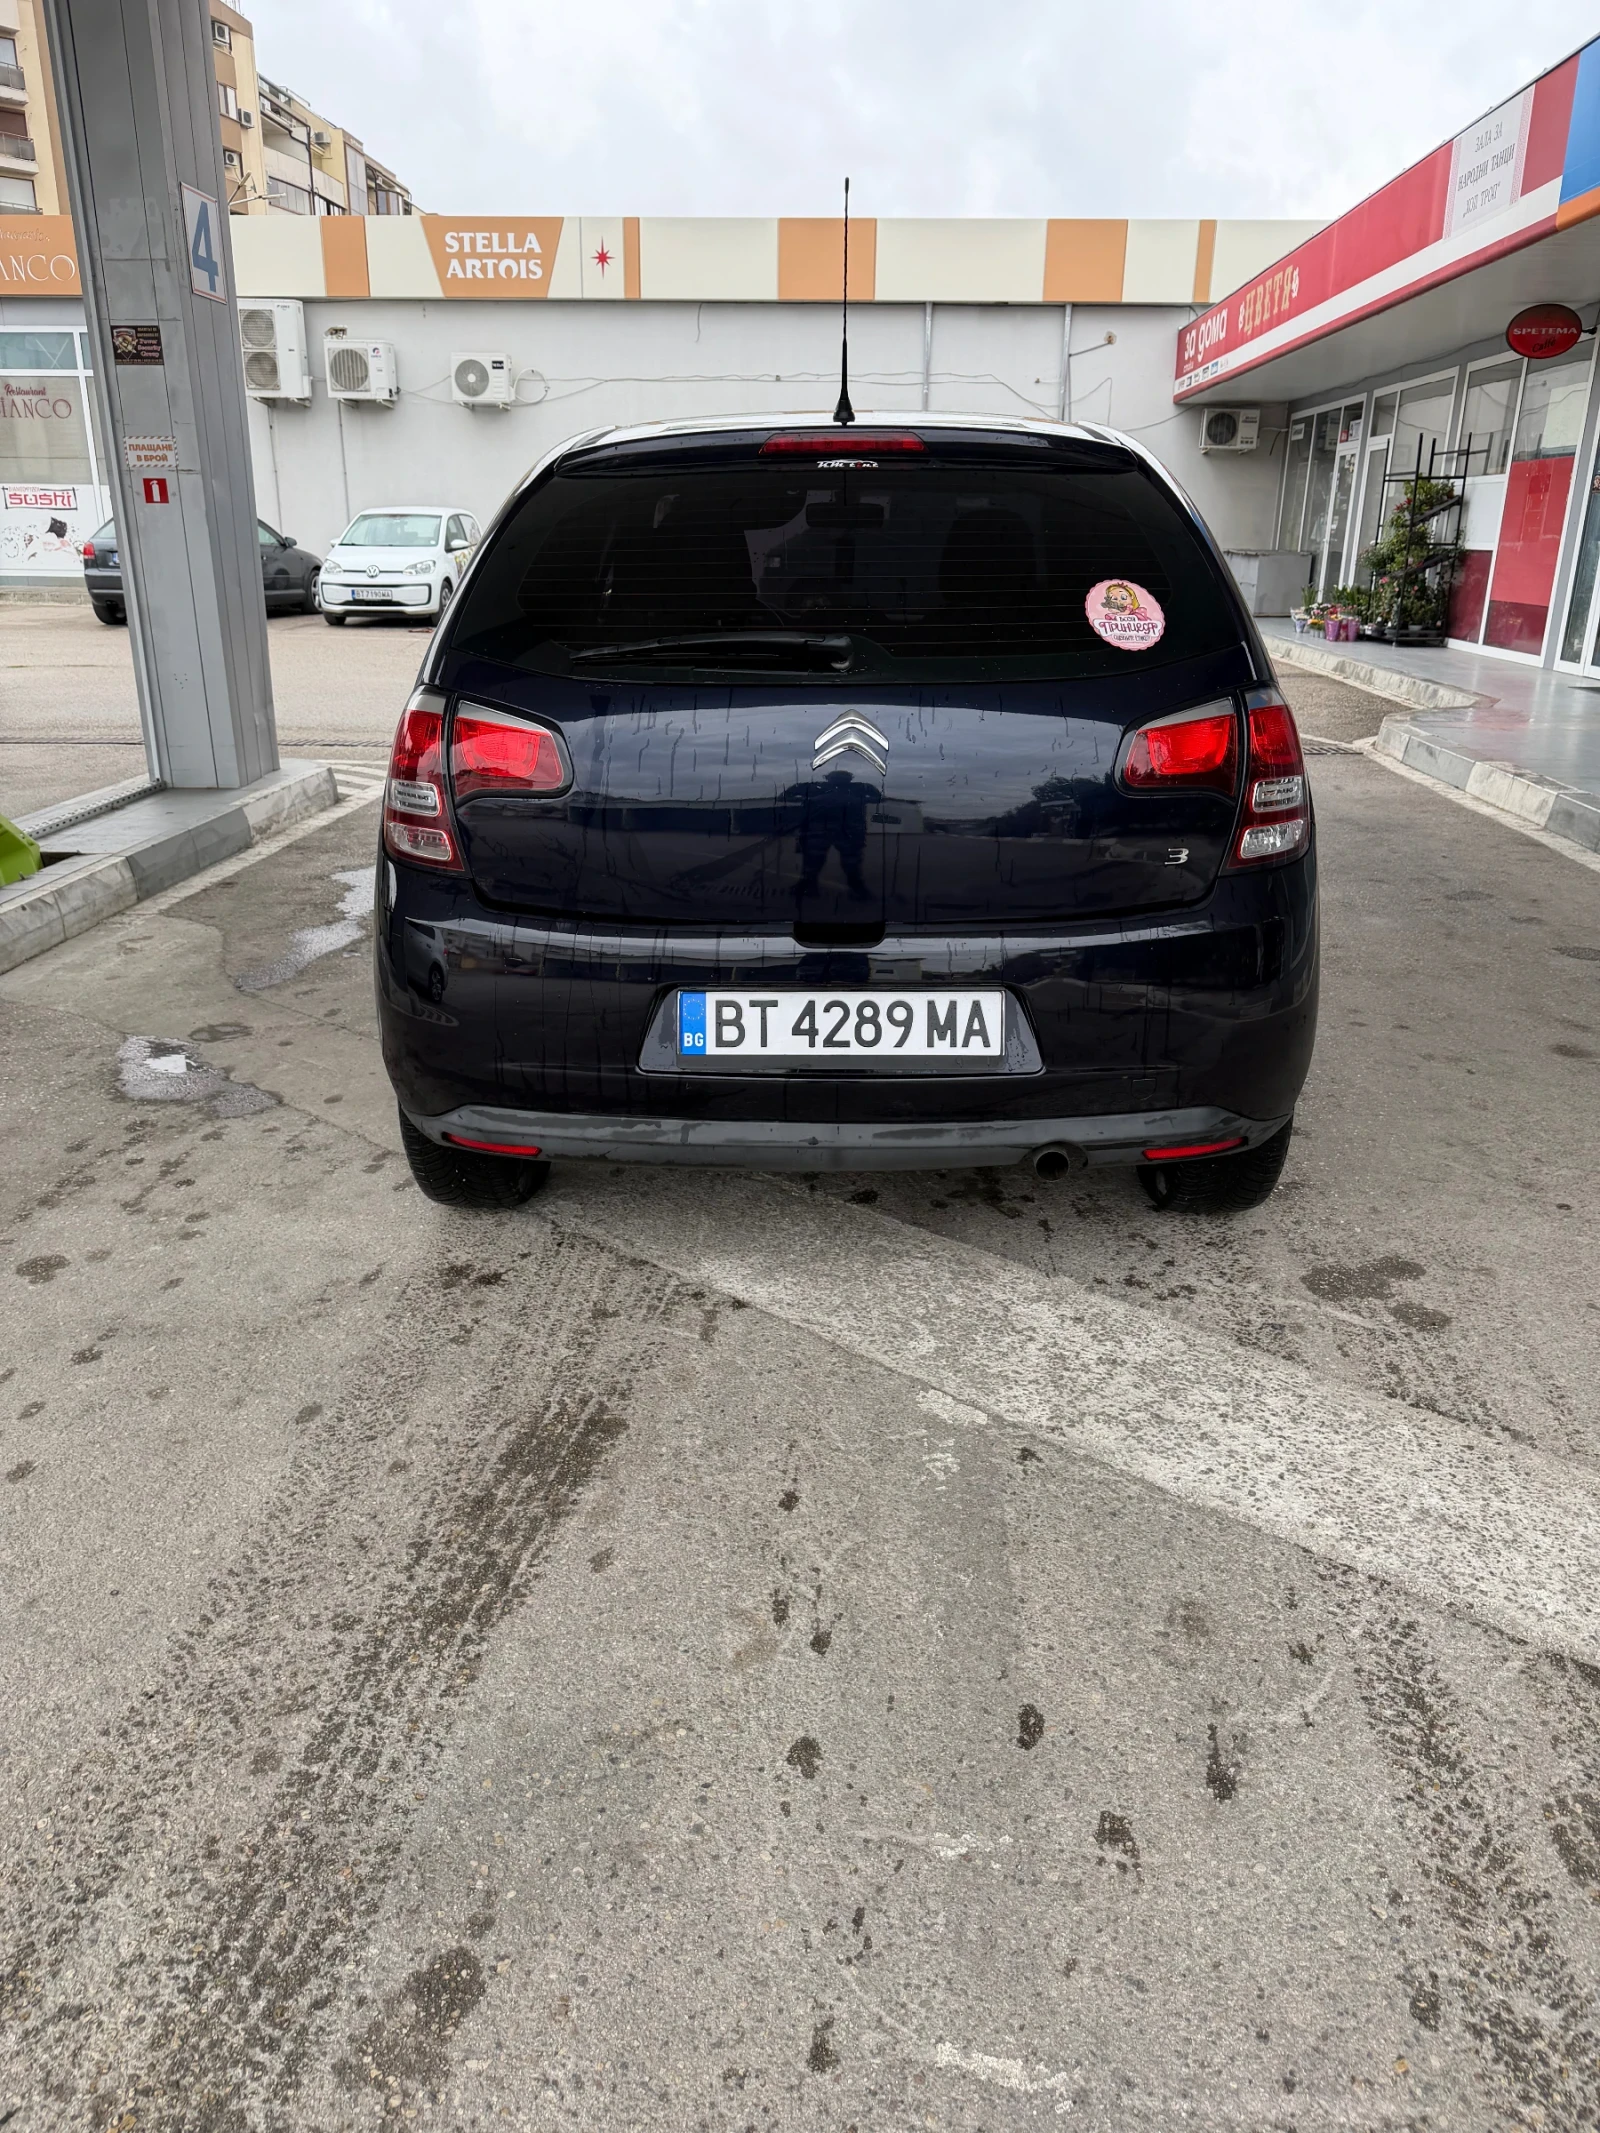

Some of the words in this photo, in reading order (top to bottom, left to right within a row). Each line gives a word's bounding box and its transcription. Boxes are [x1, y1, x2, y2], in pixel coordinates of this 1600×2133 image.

[1457, 159, 1490, 192] НАРОДНИ
[1490, 143, 1516, 172] ТАНЦИ
[191, 201, 219, 293] 4
[444, 231, 543, 254] STELLA
[446, 258, 543, 279] ARTOIS
[1243, 265, 1294, 336] ЦВЕТЯ
[1512, 327, 1578, 335] SPETEMA
[4, 383, 47, 396] Restaurant
[0, 397, 72, 419] IANCO
[128, 444, 174, 452] ПЛАЩАНЕ
[136, 454, 143, 462] В
[143, 453, 169, 462] БРОЙ
[8, 491, 72, 507] sushi
[1164, 848, 1190, 865] 3
[683, 1032, 704, 1047] BG
[715, 1000, 779, 1048] BT
[791, 1000, 915, 1048] 4289
[926, 1000, 992, 1048] MA
